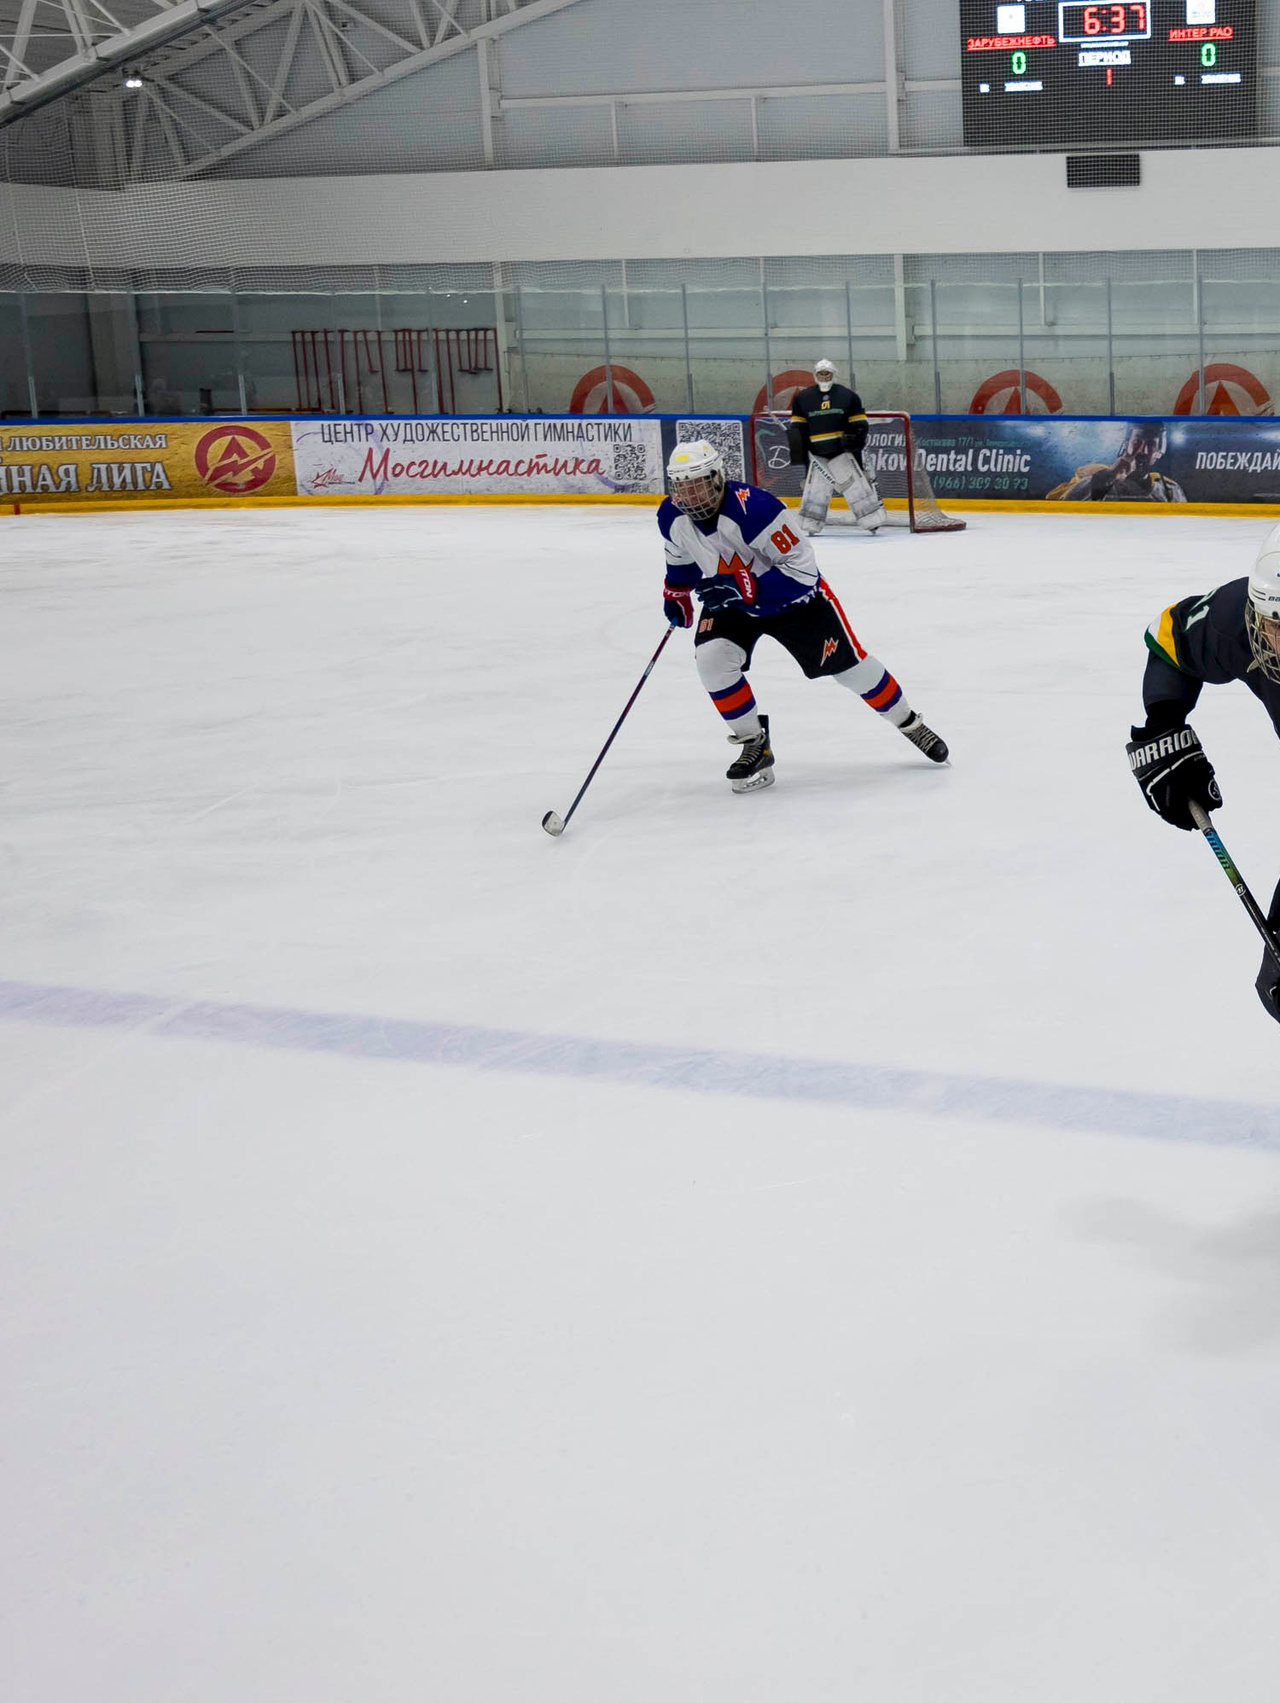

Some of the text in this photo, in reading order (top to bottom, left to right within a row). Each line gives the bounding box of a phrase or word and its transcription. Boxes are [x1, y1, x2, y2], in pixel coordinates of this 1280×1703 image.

[1083, 5, 1146, 35] 6:37
[967, 35, 1056, 49] ЗАРУБЕЖНЕФТЬ
[1169, 26, 1233, 39] ИНТЕР РАО
[1012, 51, 1027, 75] 0
[1078, 50, 1132, 66] ПЕРИОД
[1201, 42, 1216, 67] 0
[1106, 67, 1113, 86] 1
[7, 434, 168, 451] ЛЮБИТЕЛЬСКАЯ
[321, 420, 632, 445] ЦЕНТР ХУДОЖЕСТВЕННОЙ ГИМНАСТИКИ
[358, 447, 606, 483] Мосгимнастика
[913, 449, 973, 472] Dental
[978, 449, 1032, 473] Clinic
[86, 461, 172, 493] ЛИГА
[932, 476, 966, 490] (966)
[771, 523, 800, 554] 81
